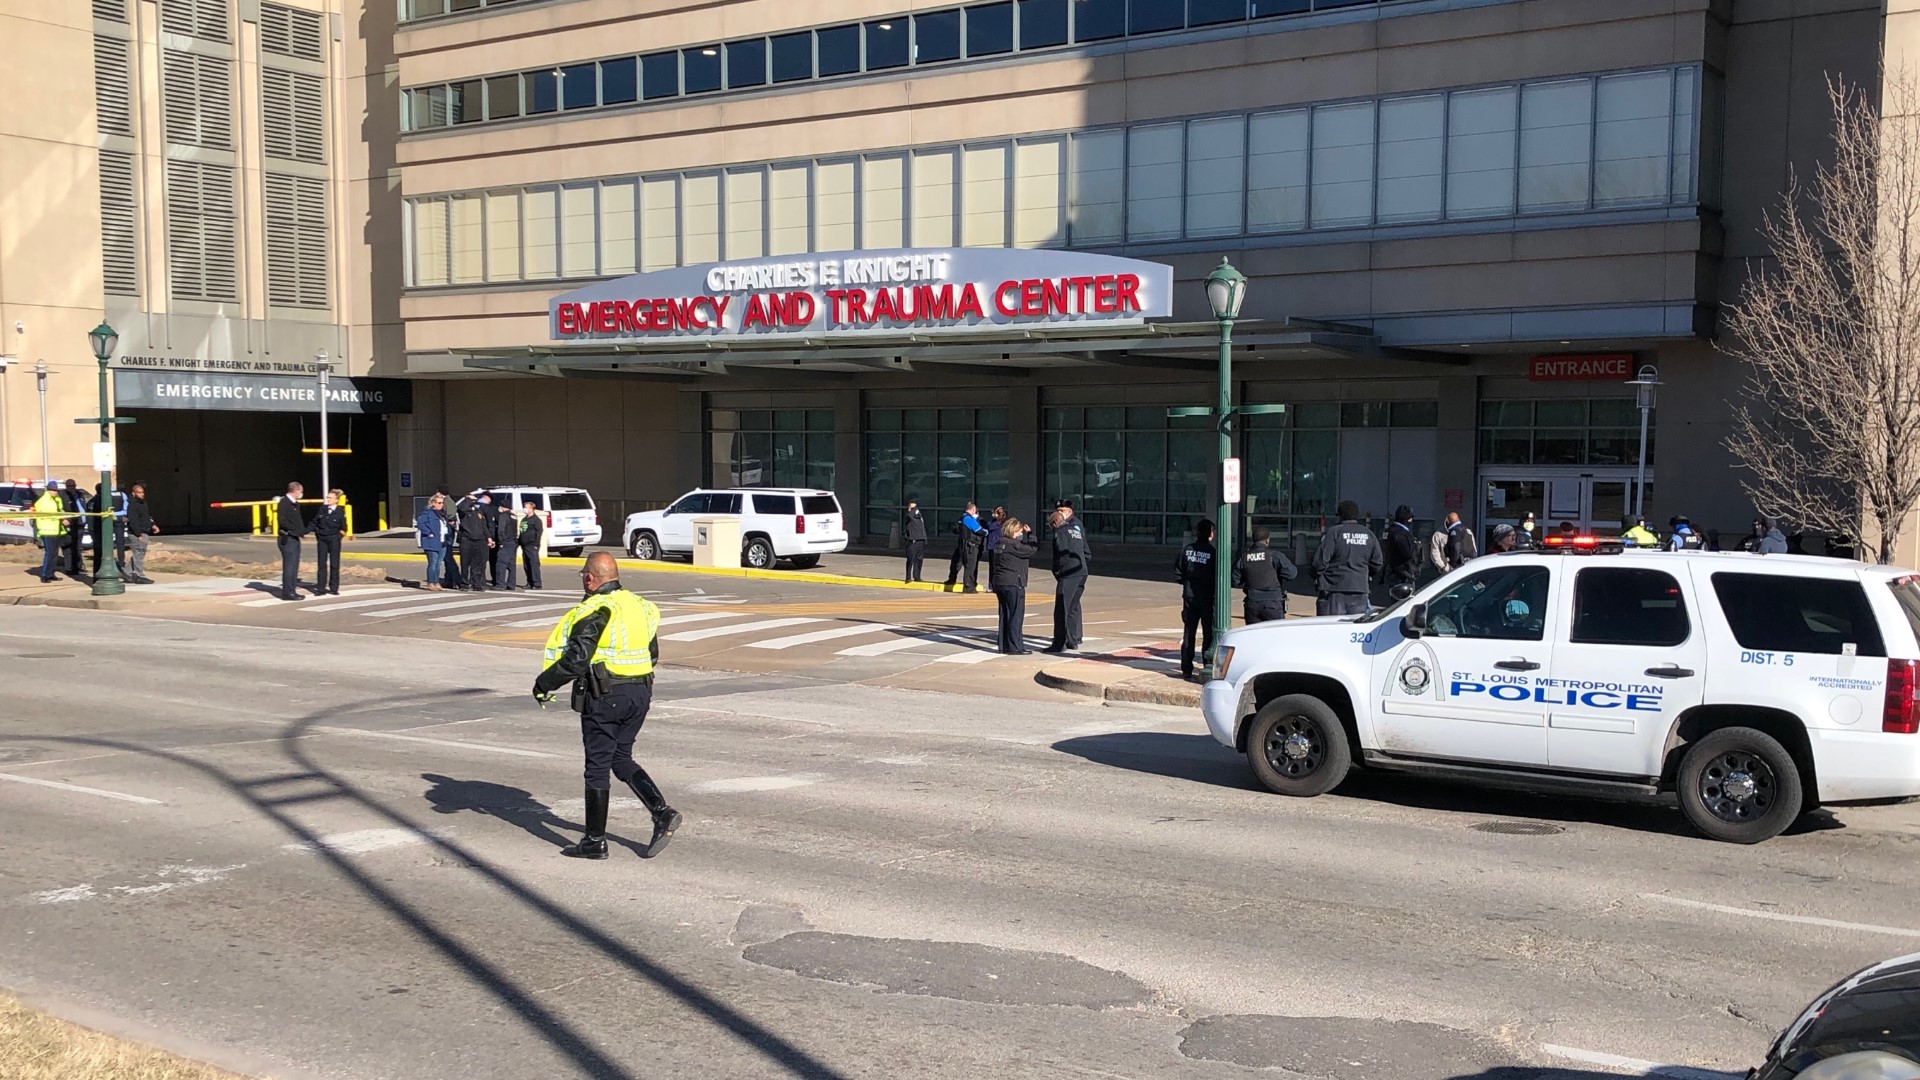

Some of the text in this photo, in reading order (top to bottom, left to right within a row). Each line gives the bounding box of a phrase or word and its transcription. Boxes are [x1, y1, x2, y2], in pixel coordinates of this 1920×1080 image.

[706, 253, 950, 291] CHARLES F. KNIGHT
[559, 273, 1141, 334] EMERGENCY AND TRAUMA CENTER
[120, 355, 158, 367] CHARLES
[169, 358, 202, 369] KNIGHT
[203, 359, 252, 371] EMERGENCY
[253, 362, 272, 371] AND
[273, 362, 306, 373] TRAUMA
[1535, 360, 1627, 376] ENTRANCE
[156, 383, 384, 403] EMERGENCY CENTER PARKING
[1346, 538, 1367, 546] POLICE
[1187, 555, 1207, 565] POLICE
[1246, 552, 1266, 562] POLICE
[1350, 632, 1372, 644] 320
[1740, 651, 1794, 666] DIST. 5
[1451, 671, 1664, 694] ST. LOUIS METROPOLITAN
[1809, 676, 1883, 686] INTERNATIONALLY
[1817, 682, 1873, 691] ACCREDITED
[1450, 681, 1663, 712] POLICE
